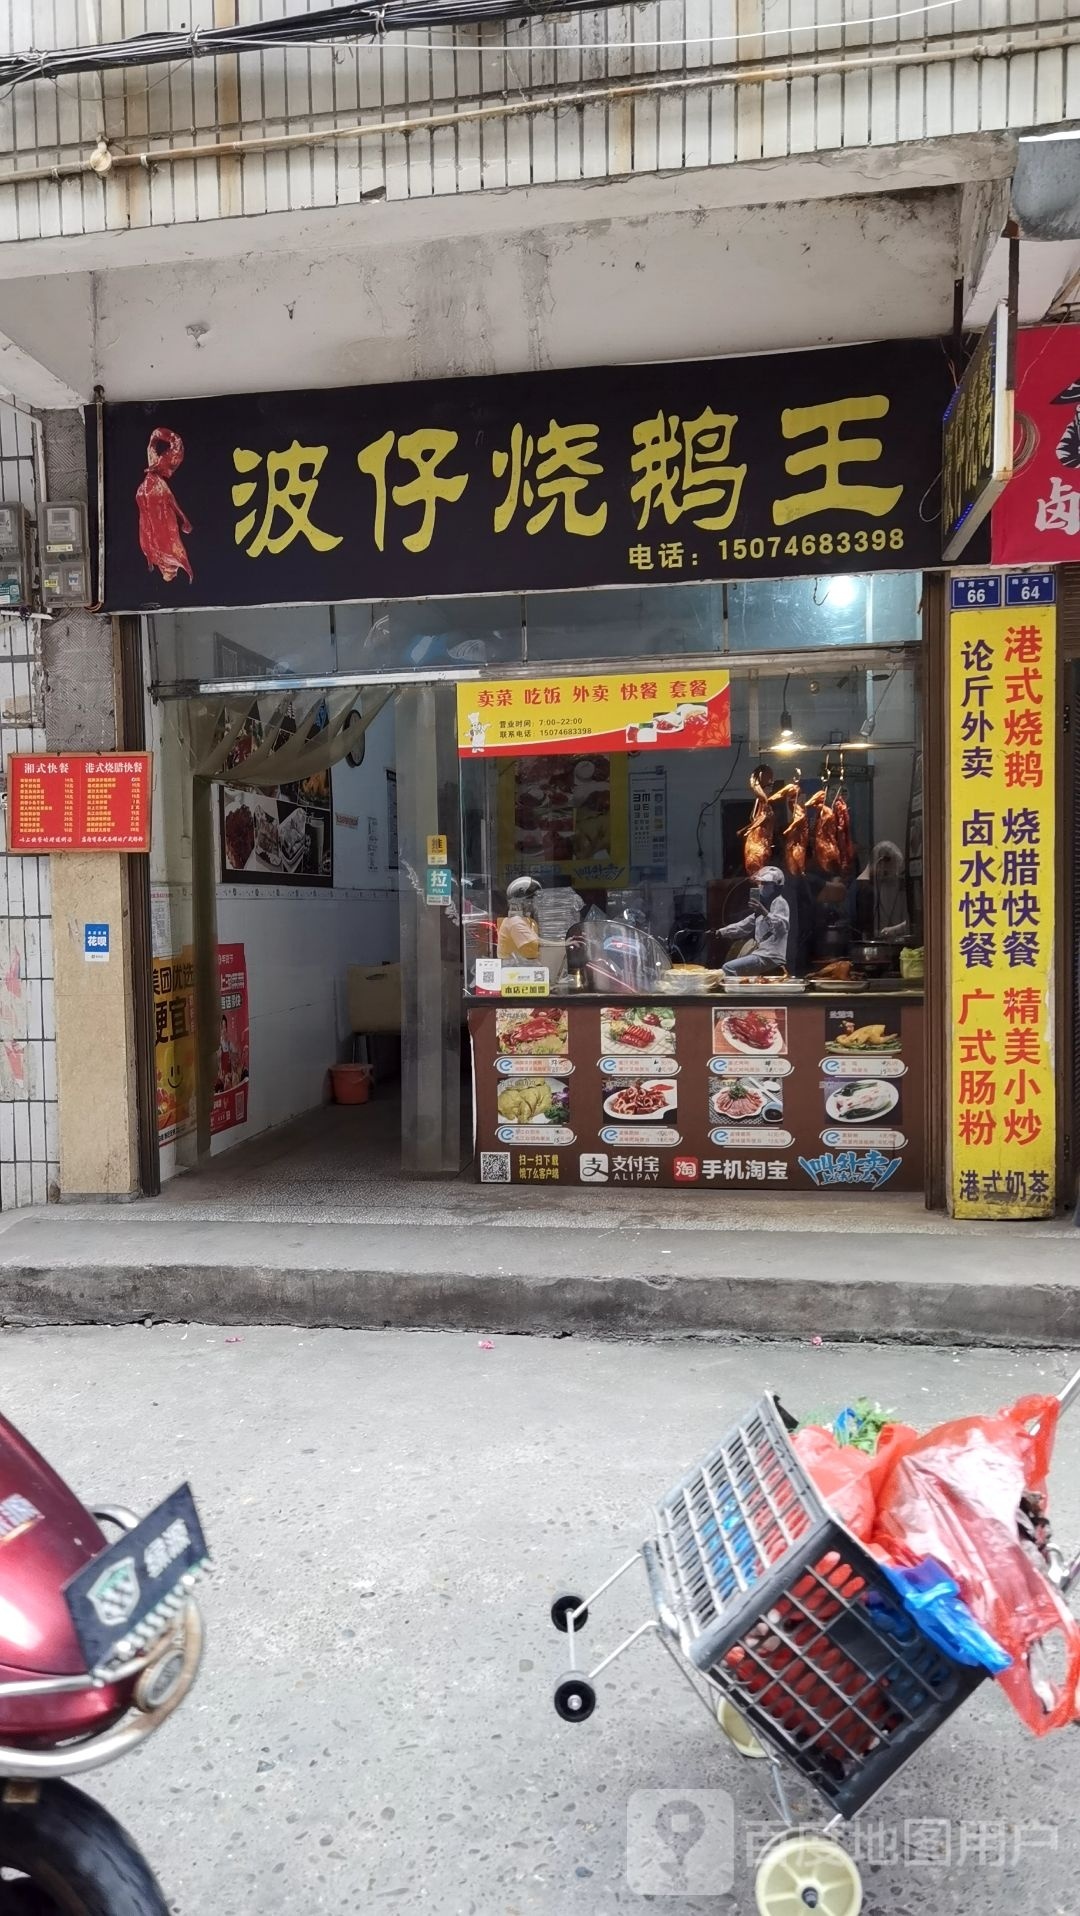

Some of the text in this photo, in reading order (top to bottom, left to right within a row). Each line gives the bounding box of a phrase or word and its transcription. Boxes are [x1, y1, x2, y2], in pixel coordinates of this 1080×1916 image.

[232, 395, 904, 557] 波仔烧鹅王
[718, 528, 905, 561] 15074683398
[967, 589, 986, 603] 66
[1021, 586, 1040, 600] 64
[477, 680, 708, 707] 卖菜 吃饭 外卖 快餐 套餐
[1004, 625, 1043, 788] 港式烧鹅
[961, 639, 994, 779] 论斤外卖
[540, 727, 592, 737] 15074683398
[24, 763, 70, 774] 湘式快餐
[431, 870, 448, 887] 拉
[959, 809, 997, 969] 卤水快餐
[1001, 807, 1041, 968] 烧腊快餐
[87, 935, 107, 947] 花呗
[958, 988, 996, 1146] 广式肠粉
[1004, 987, 1042, 1146] 精美小炒
[612, 1156, 659, 1172] 支付宝
[614, 1173, 659, 1181] ALIPAY
[702, 1159, 788, 1180] 手机淘宝
[958, 1169, 1050, 1203] 港式奶茶
